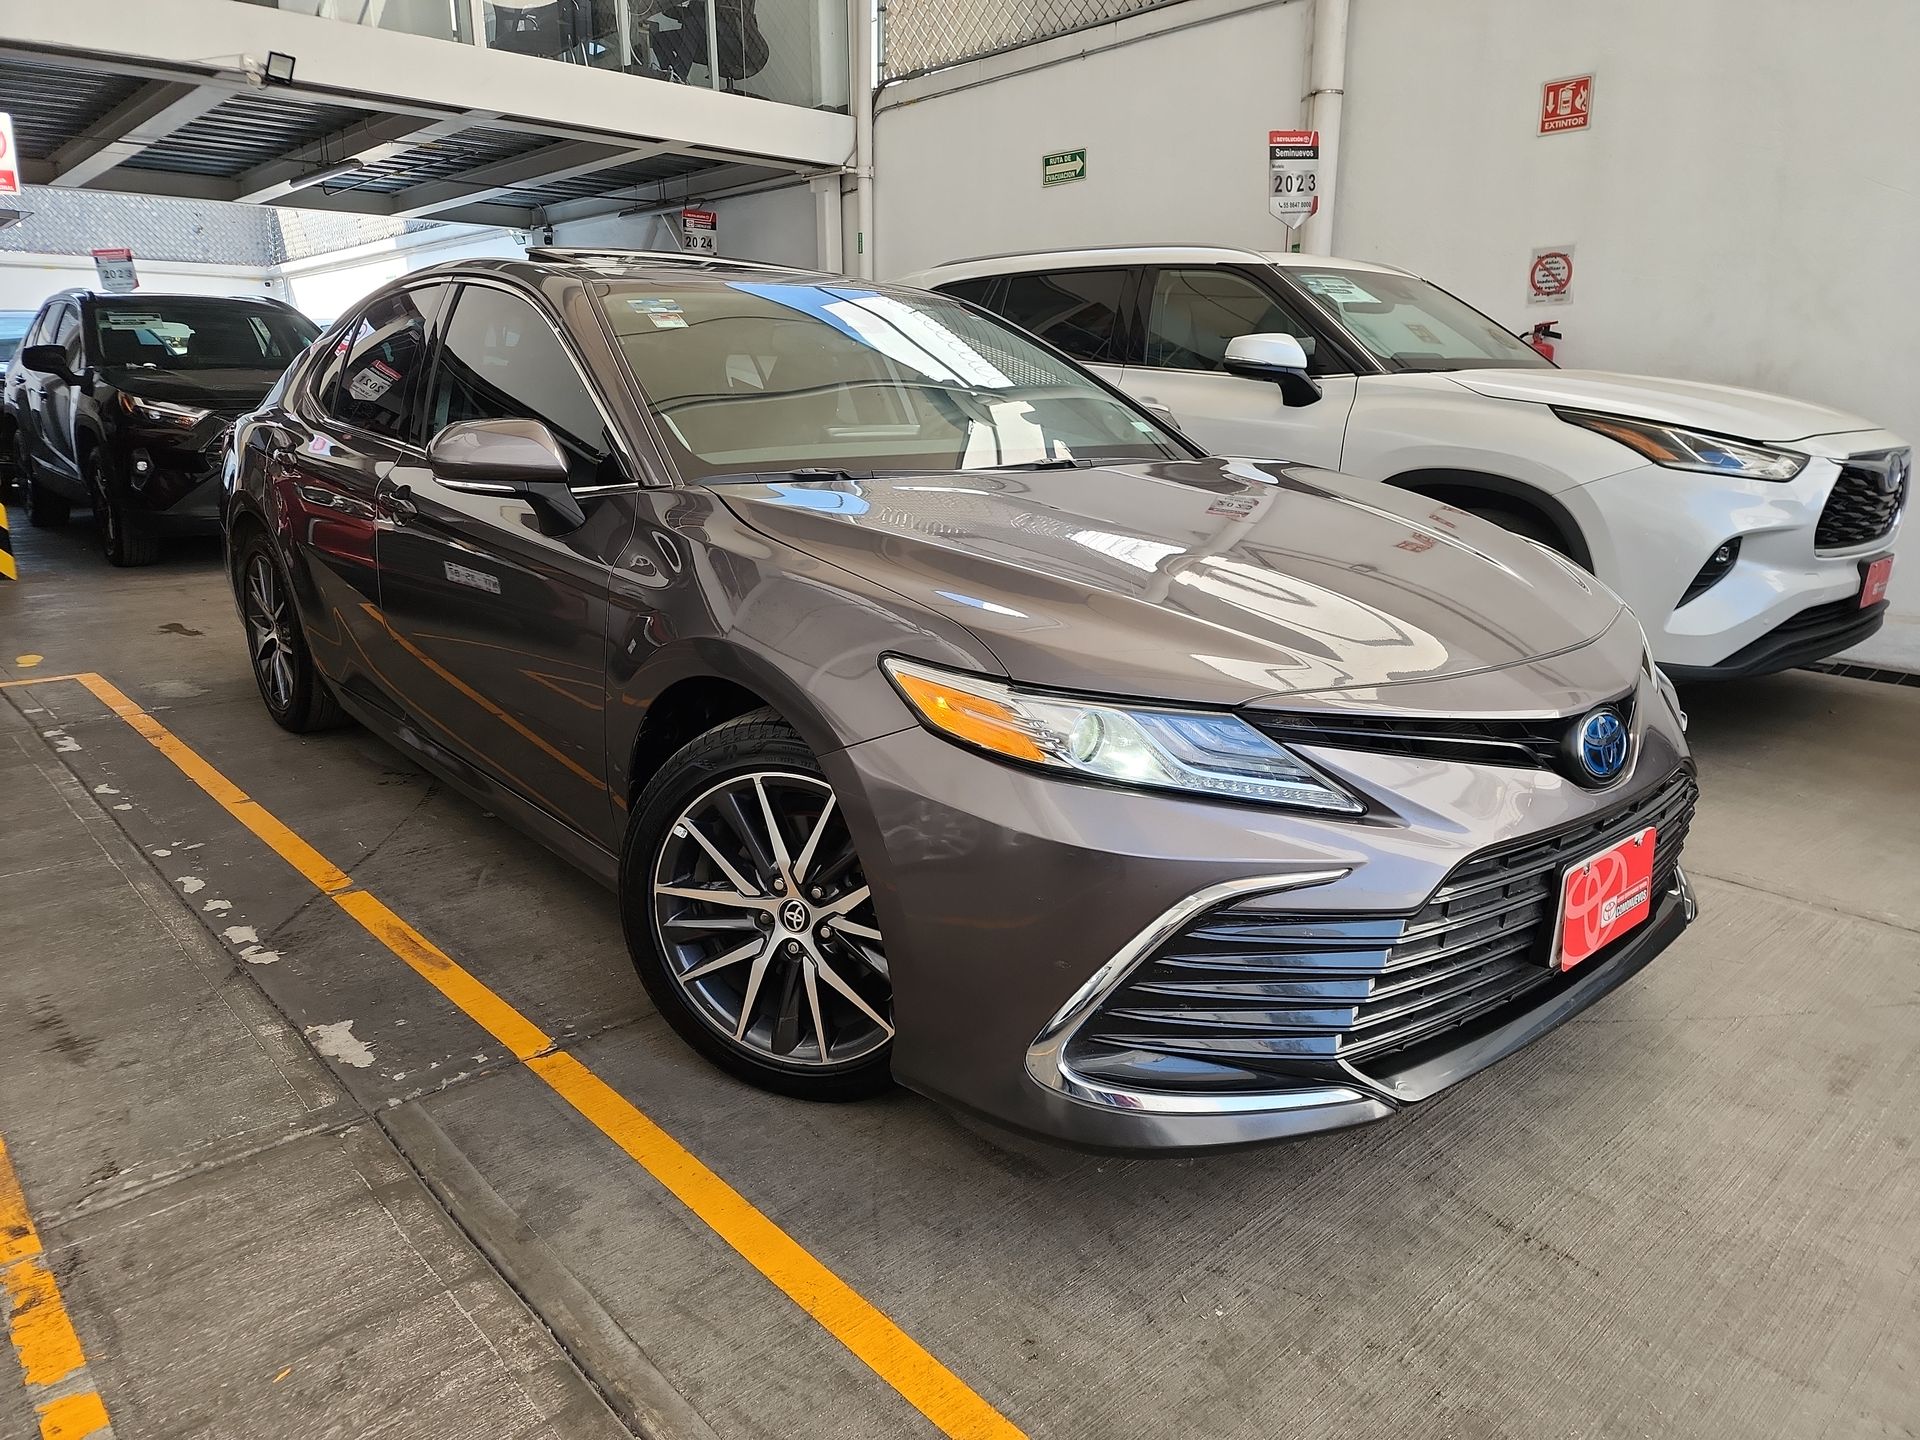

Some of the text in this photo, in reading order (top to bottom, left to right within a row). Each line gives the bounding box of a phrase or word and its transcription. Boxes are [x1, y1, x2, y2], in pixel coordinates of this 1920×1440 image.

[1544, 117, 1585, 130] EXTINTOR
[1275, 148, 1314, 157] Seminuevos
[1049, 156, 1064, 165] RUTA
[1274, 174, 1316, 193] 2023
[685, 236, 713, 249] 2024
[102, 269, 133, 279] 2023
